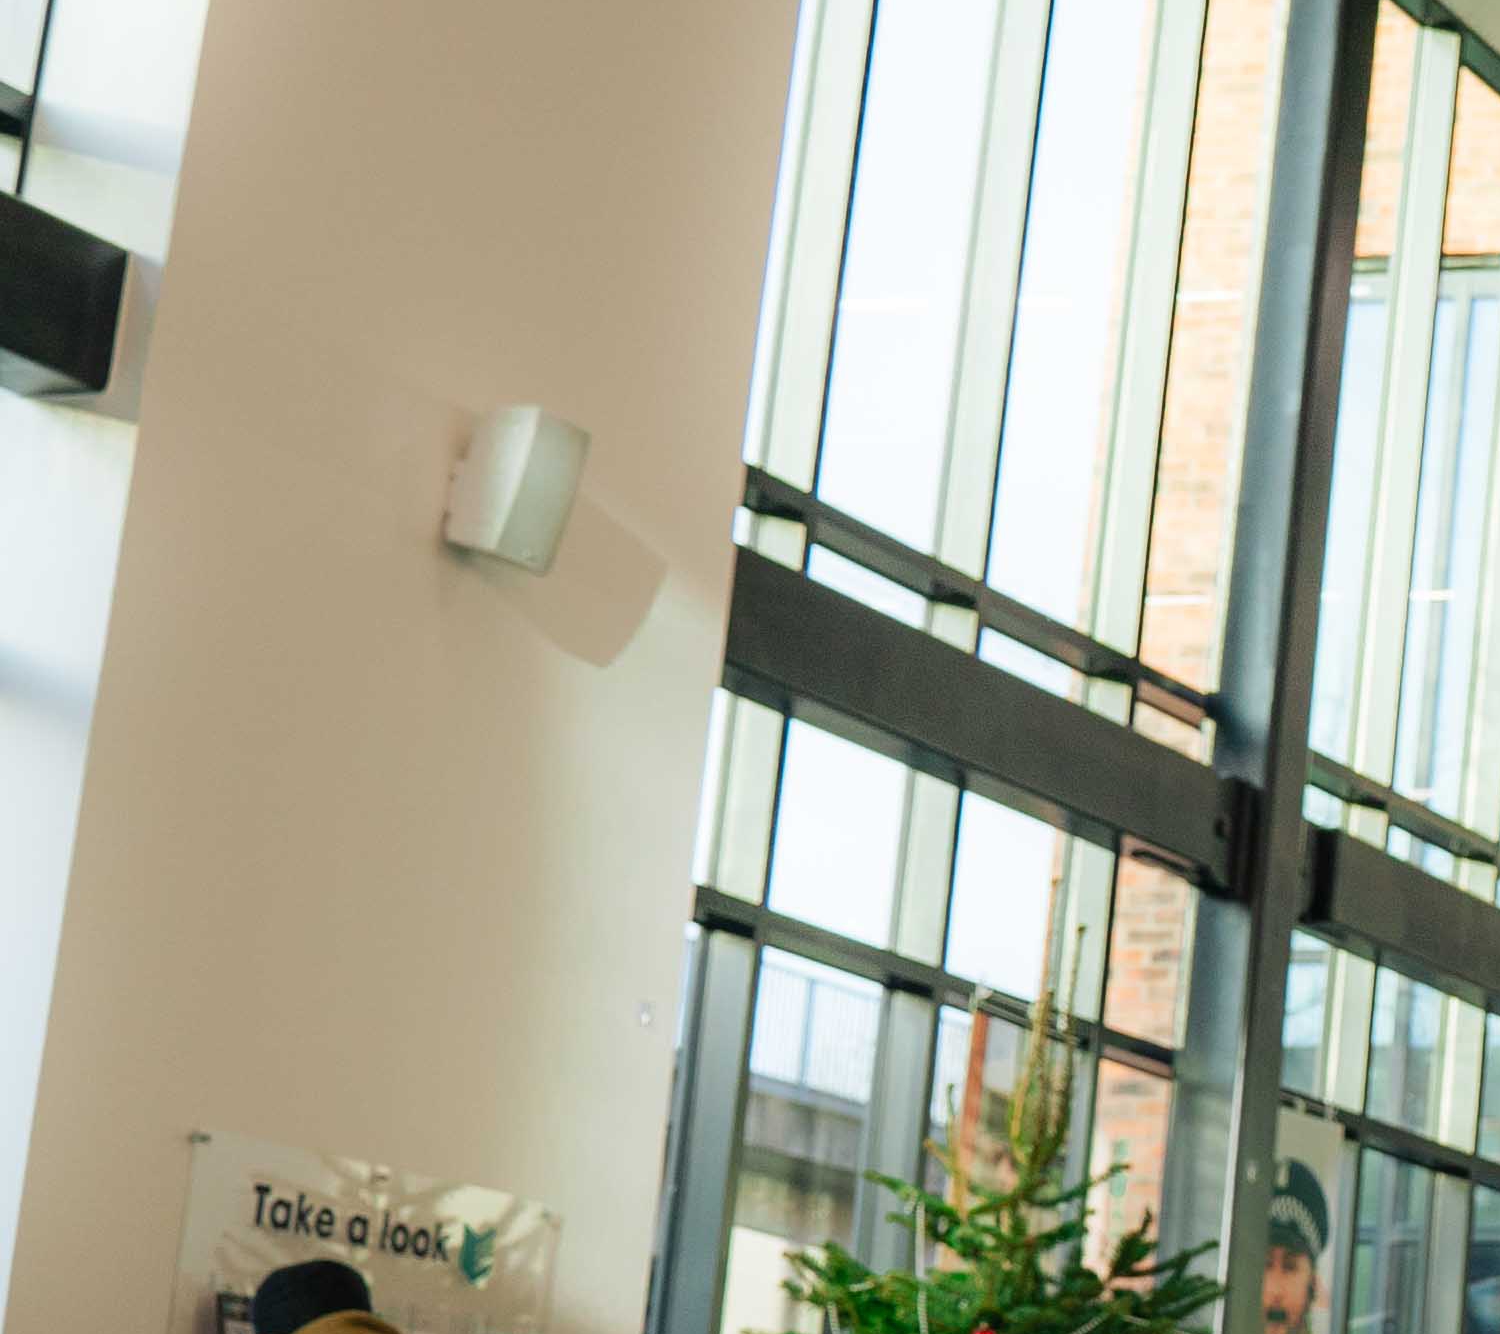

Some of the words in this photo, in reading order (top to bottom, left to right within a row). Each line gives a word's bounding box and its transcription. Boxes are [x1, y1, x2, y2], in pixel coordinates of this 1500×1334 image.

[253, 1183, 336, 1240] Take
[347, 1213, 369, 1247] a
[378, 1211, 449, 1263] look
